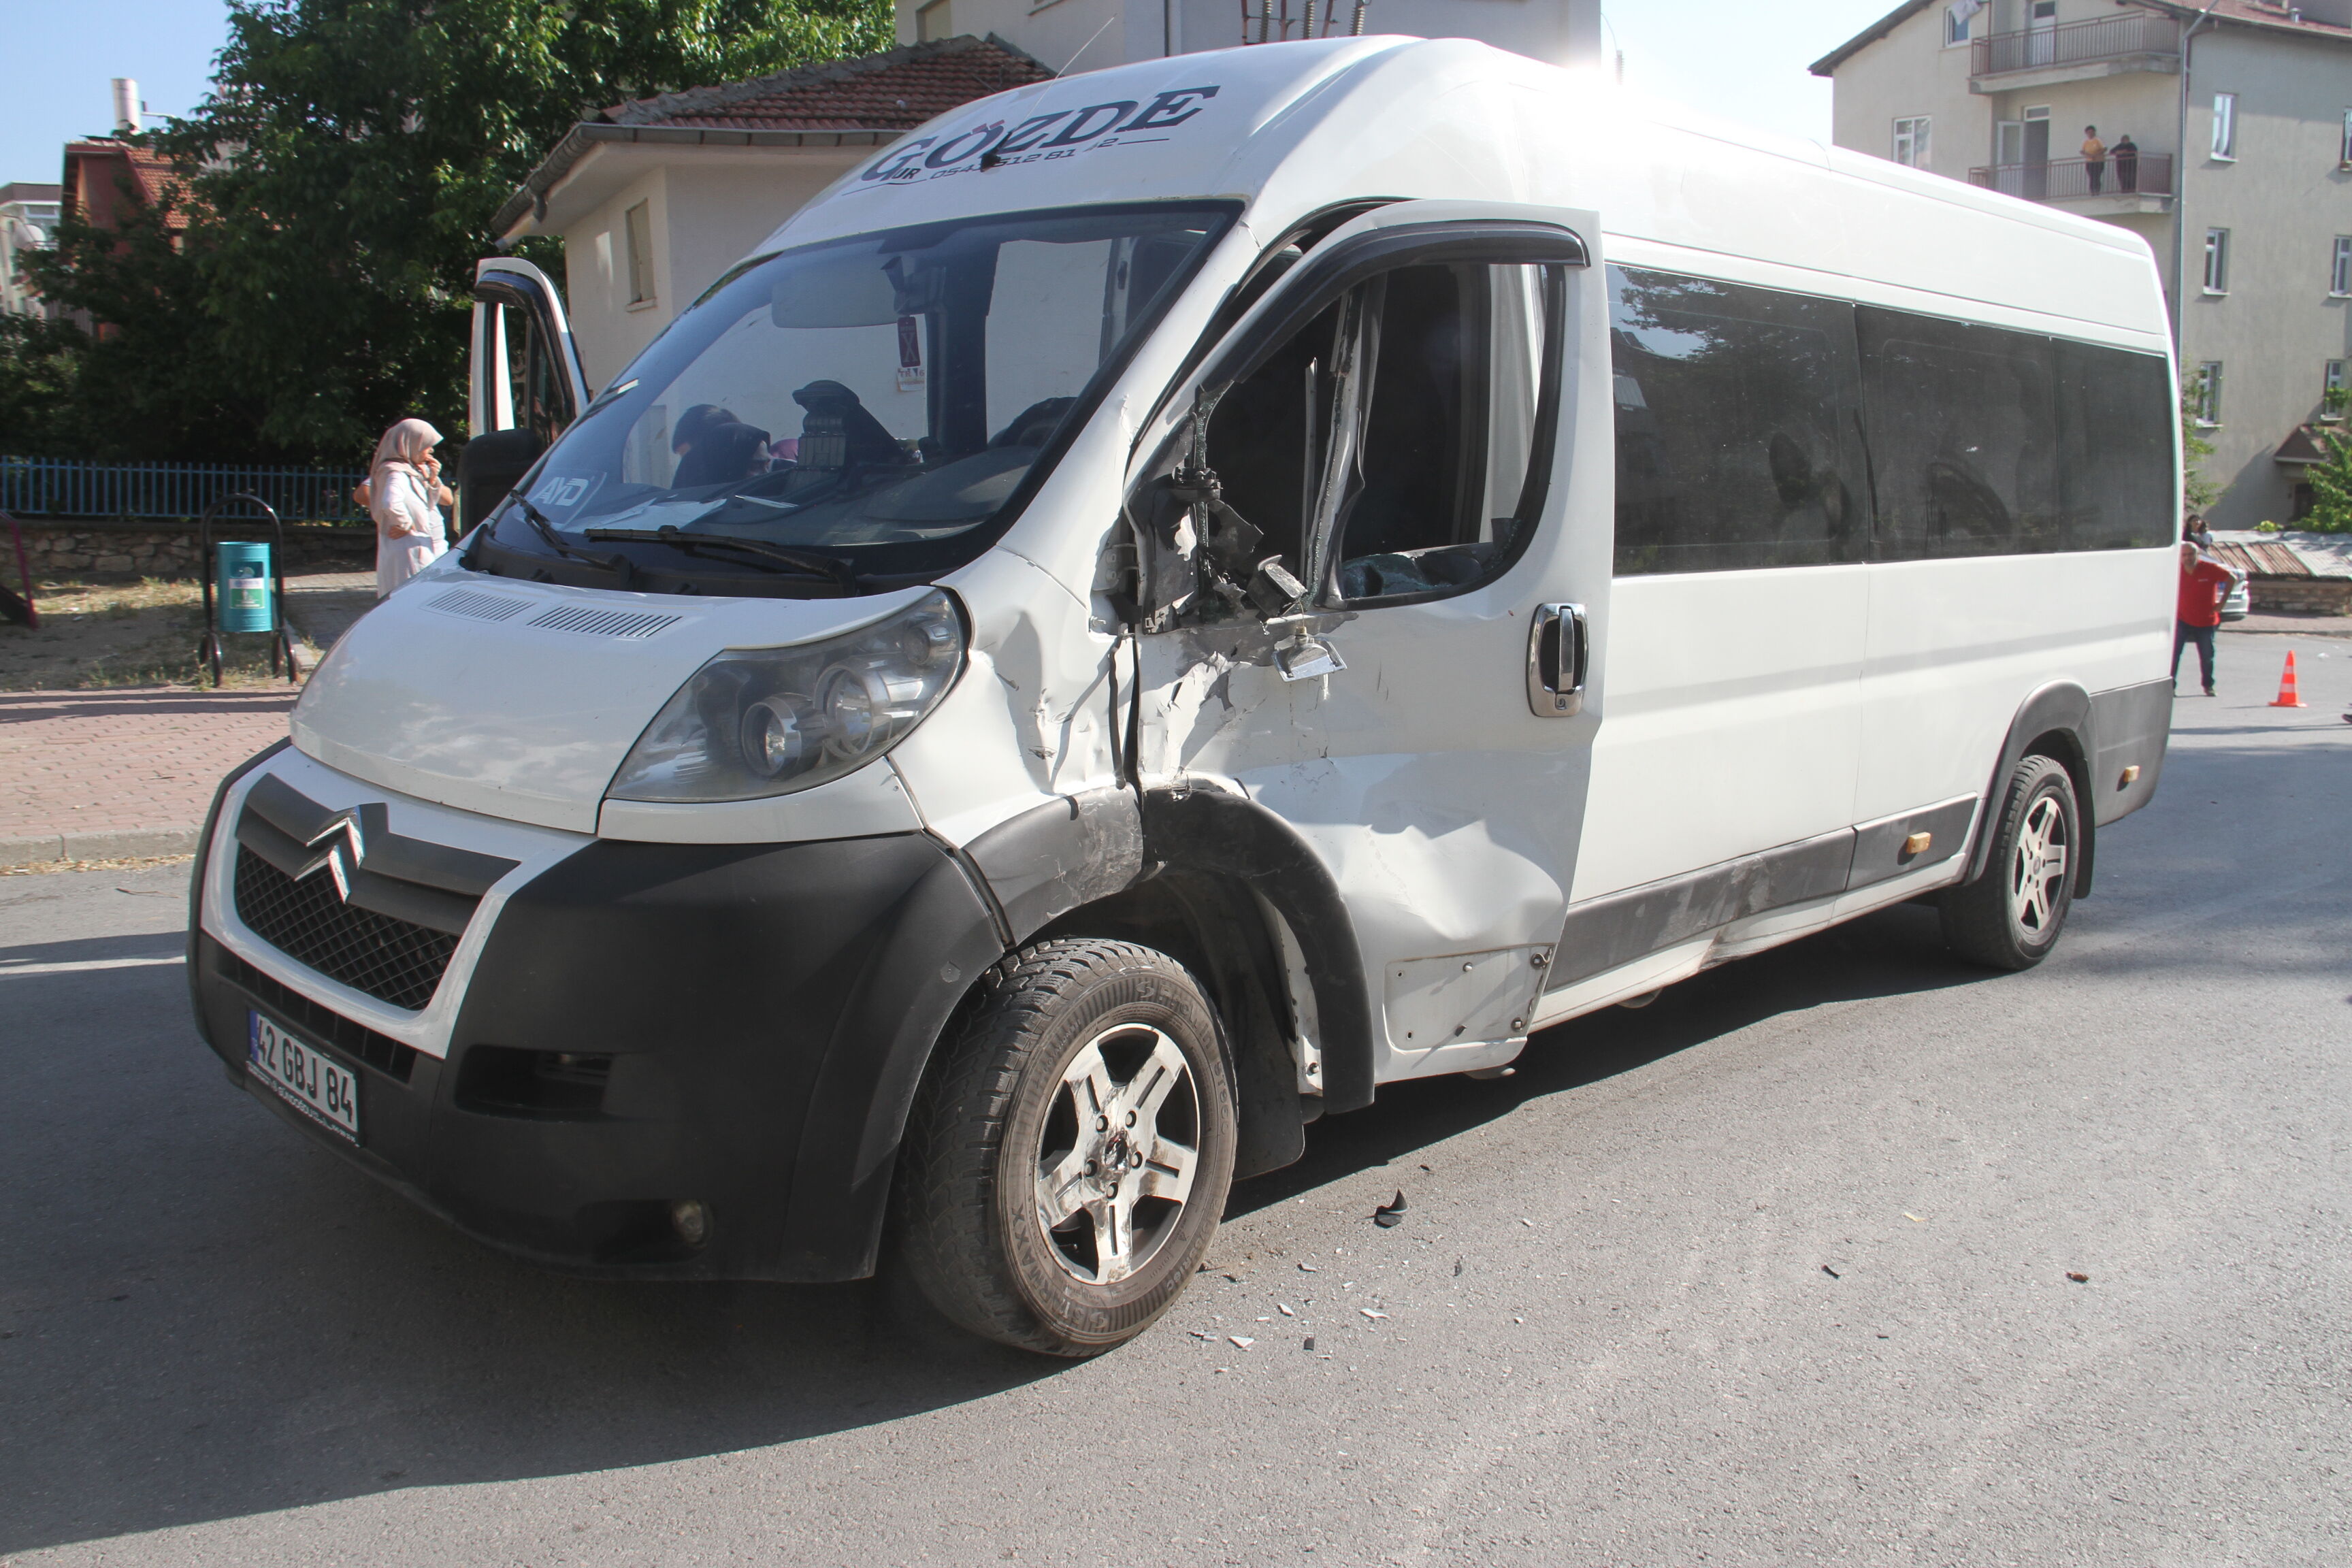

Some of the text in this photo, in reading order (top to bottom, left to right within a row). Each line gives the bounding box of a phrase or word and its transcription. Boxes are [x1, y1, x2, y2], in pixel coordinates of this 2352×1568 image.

[862, 86, 1221, 182] GÖZDE
[992, 154, 1042, 167] 512
[1044, 149, 1076, 160] 81
[258, 1019, 276, 1071] 42
[282, 1037, 318, 1099] GBJ
[326, 1066, 353, 1123] 84
